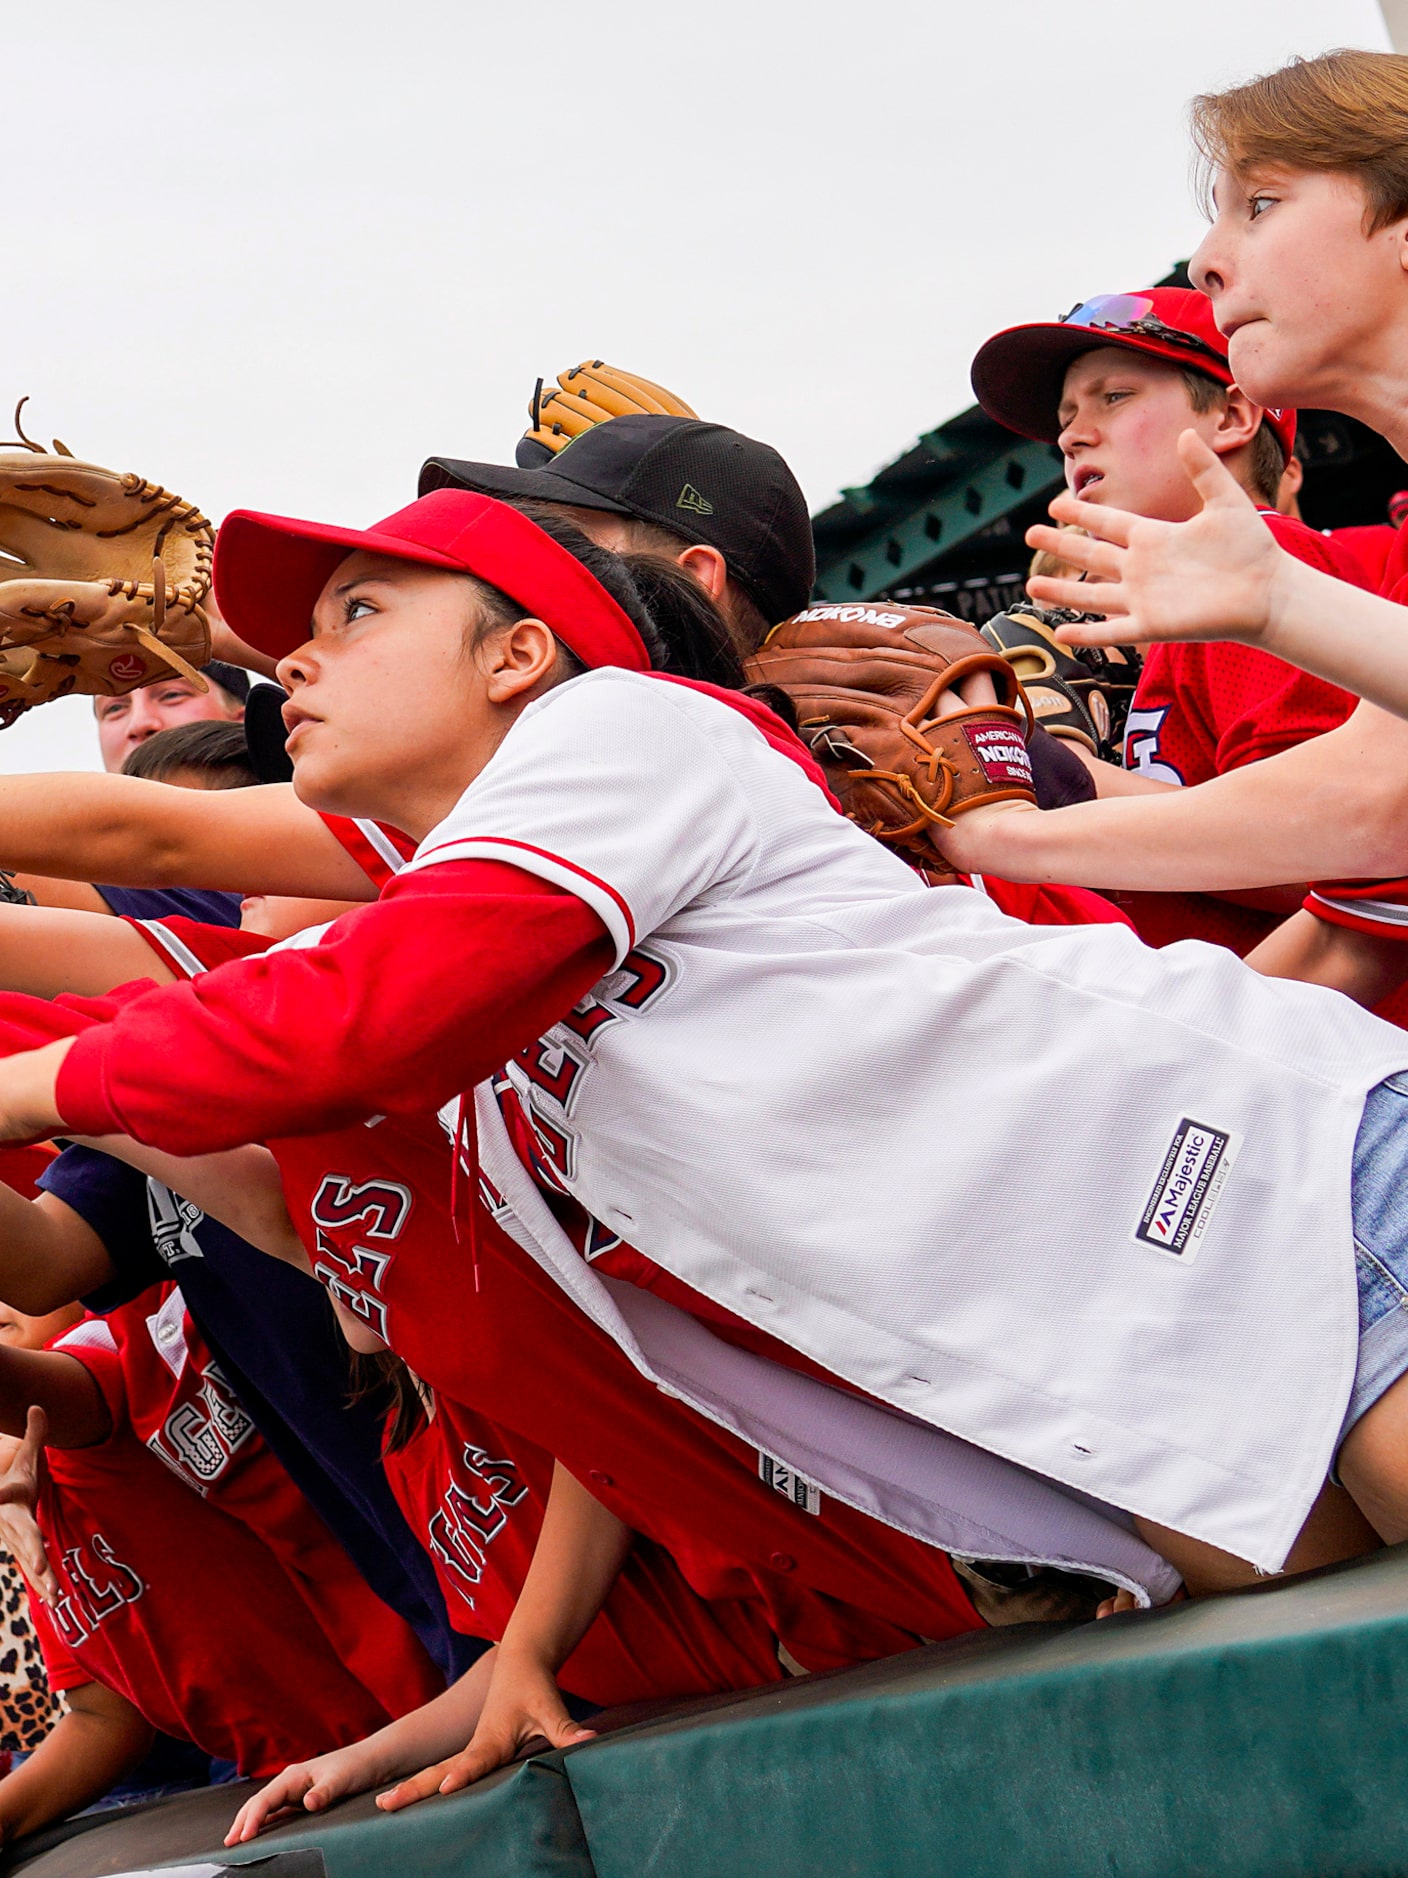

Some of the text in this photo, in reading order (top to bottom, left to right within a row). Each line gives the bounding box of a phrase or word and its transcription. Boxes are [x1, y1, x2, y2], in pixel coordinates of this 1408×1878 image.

[1165, 1135, 1204, 1207] Majestic
[1173, 1137, 1225, 1248] MAJOR LEAGUE BASEBALL
